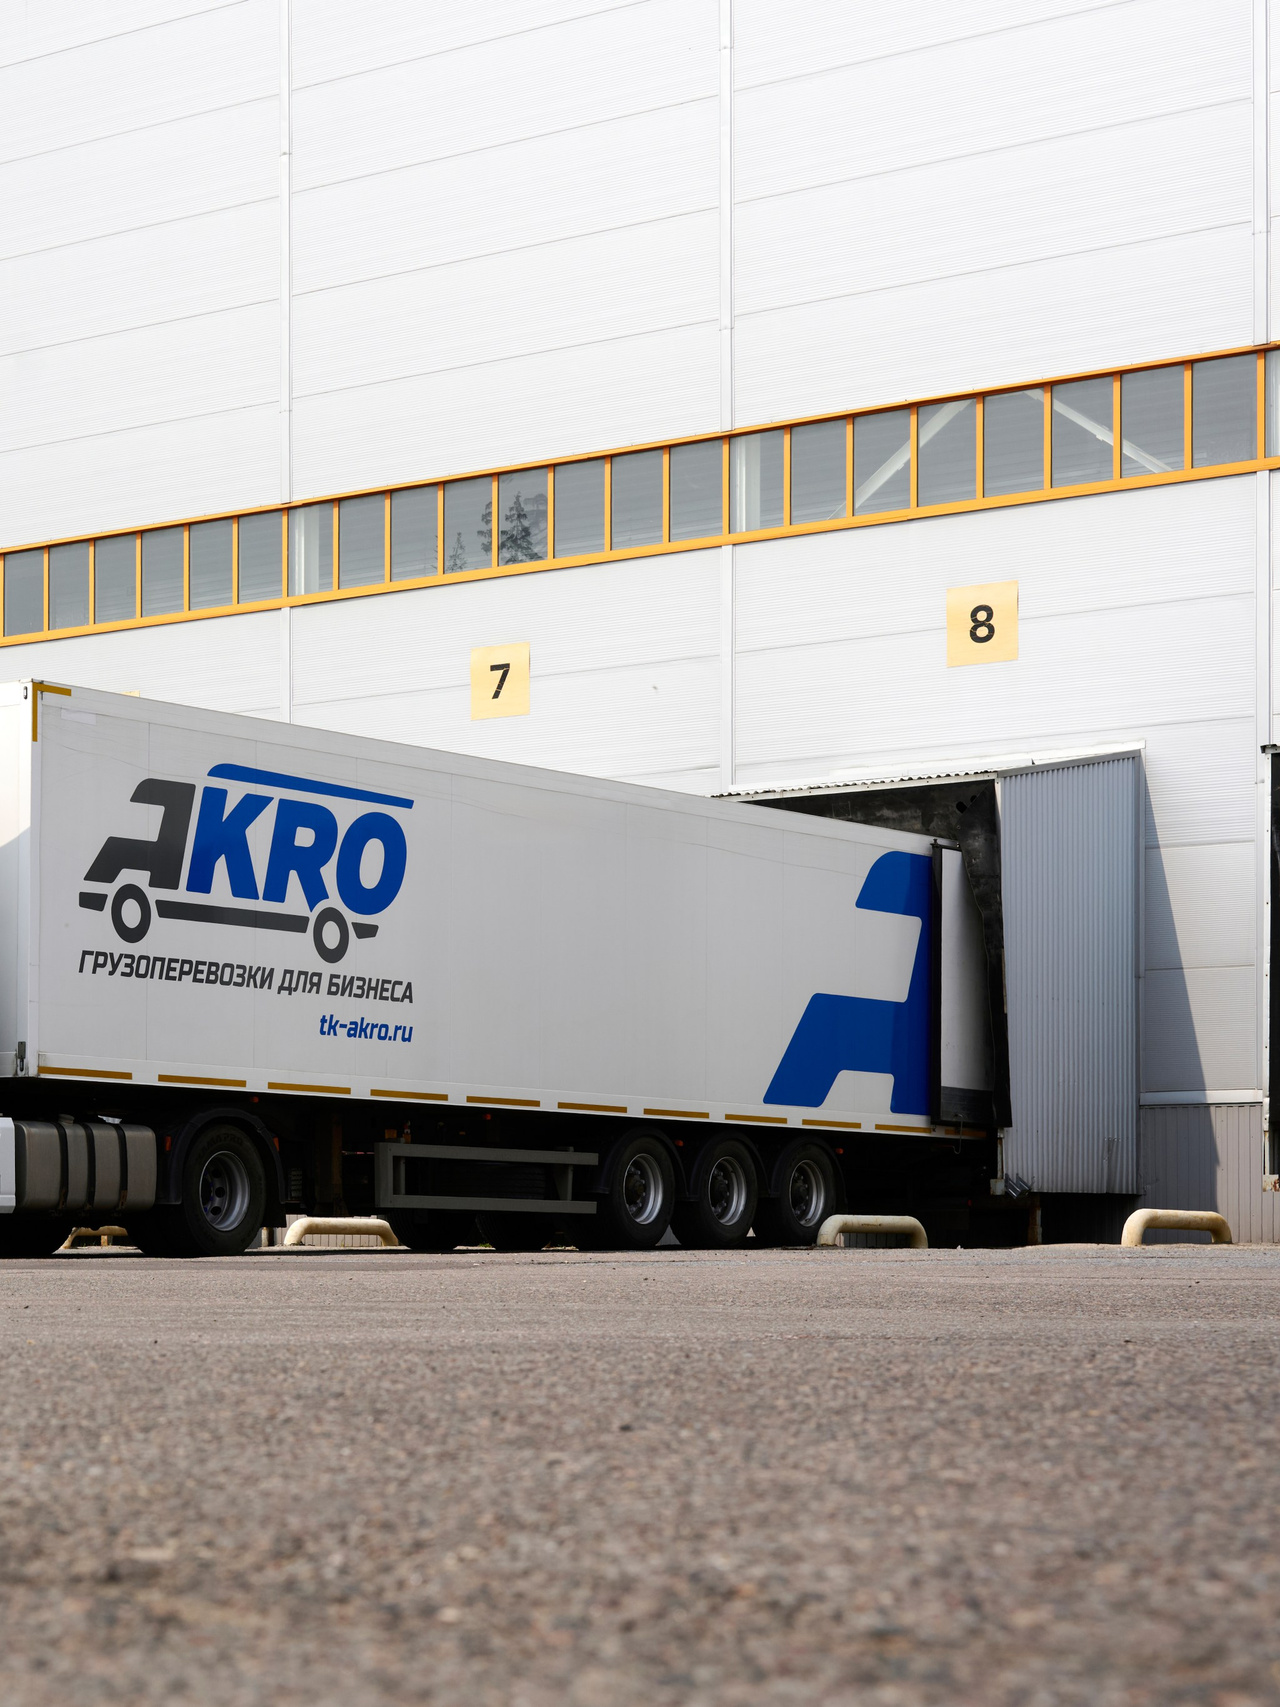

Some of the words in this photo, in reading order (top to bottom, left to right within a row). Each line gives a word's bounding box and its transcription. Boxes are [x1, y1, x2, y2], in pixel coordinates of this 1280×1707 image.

[969, 604, 995, 643] 8
[490, 663, 510, 699] 7
[78, 950, 275, 990] ГРУЗОПЕРЕВОЗКИ
[277, 968, 323, 996] ДЛЯ
[326, 974, 415, 1004] БИЗНЕСА
[319, 1014, 414, 1043] tk-akro.ru
